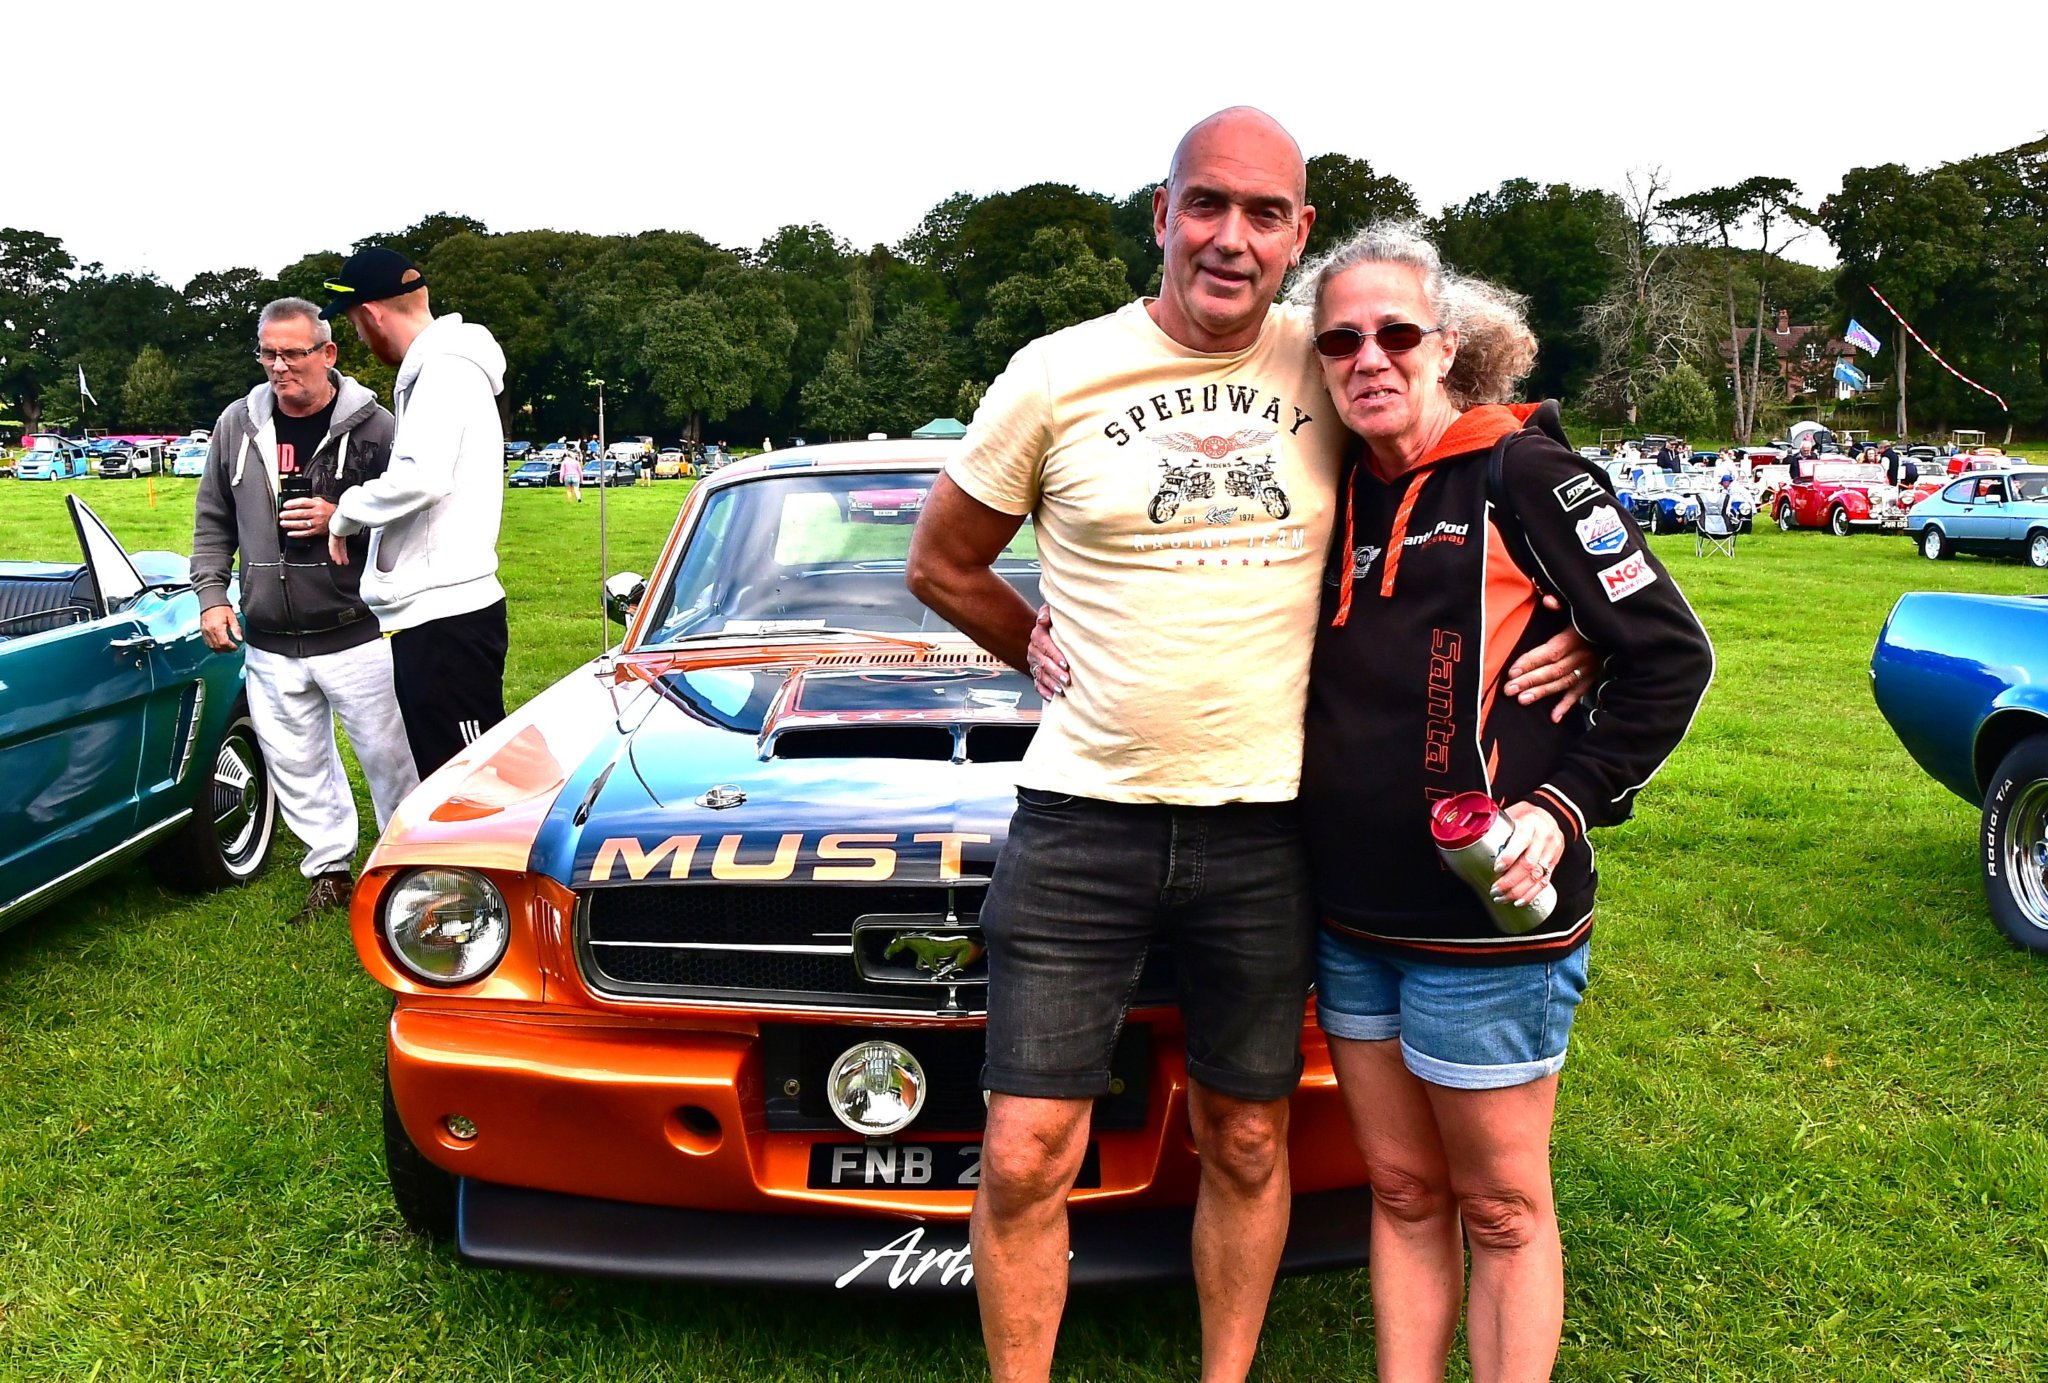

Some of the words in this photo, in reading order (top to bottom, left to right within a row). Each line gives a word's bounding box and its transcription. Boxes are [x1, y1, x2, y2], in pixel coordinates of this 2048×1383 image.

[1104, 383, 1312, 446] SPEEDWAY
[277, 443, 300, 473] D.
[1403, 530, 1433, 546] ant
[1434, 520, 1469, 536] Pod
[1604, 557, 1646, 590] NGK
[1611, 582, 1635, 597] SPARK
[1425, 628, 1462, 773] Santa
[588, 833, 992, 882] MUST
[831, 1146, 932, 1185] FNB
